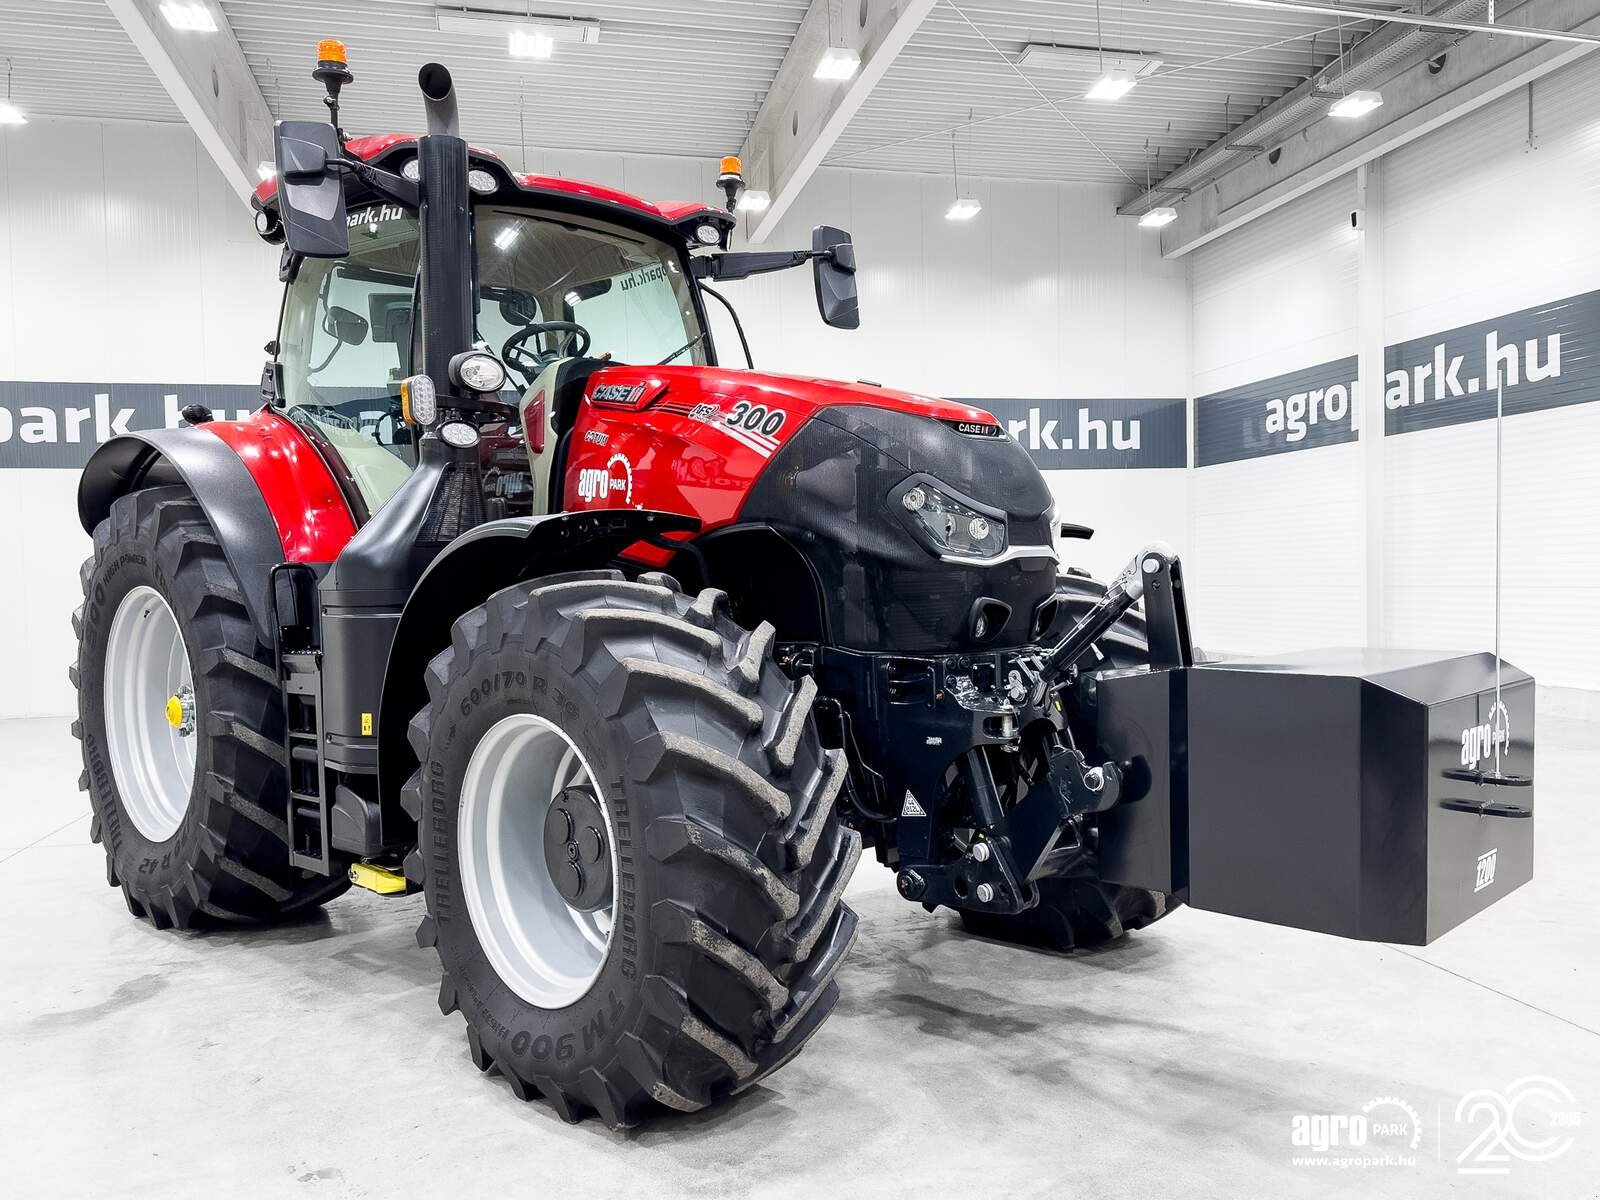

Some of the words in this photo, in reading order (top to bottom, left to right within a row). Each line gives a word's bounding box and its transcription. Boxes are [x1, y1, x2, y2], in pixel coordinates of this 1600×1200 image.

[592, 384, 633, 401] CASE
[726, 400, 786, 437] 300
[958, 423, 981, 434] CASE
[578, 469, 609, 502] agro
[609, 478, 627, 491] PARK
[461, 671, 527, 716] 600/70
[533, 676, 548, 695] R
[1461, 723, 1491, 769] agro
[430, 759, 452, 927] TRELLEBORG
[610, 775, 638, 981] TRELLEBORG
[1476, 853, 1497, 888] 1200
[510, 1030, 578, 1061] 900
